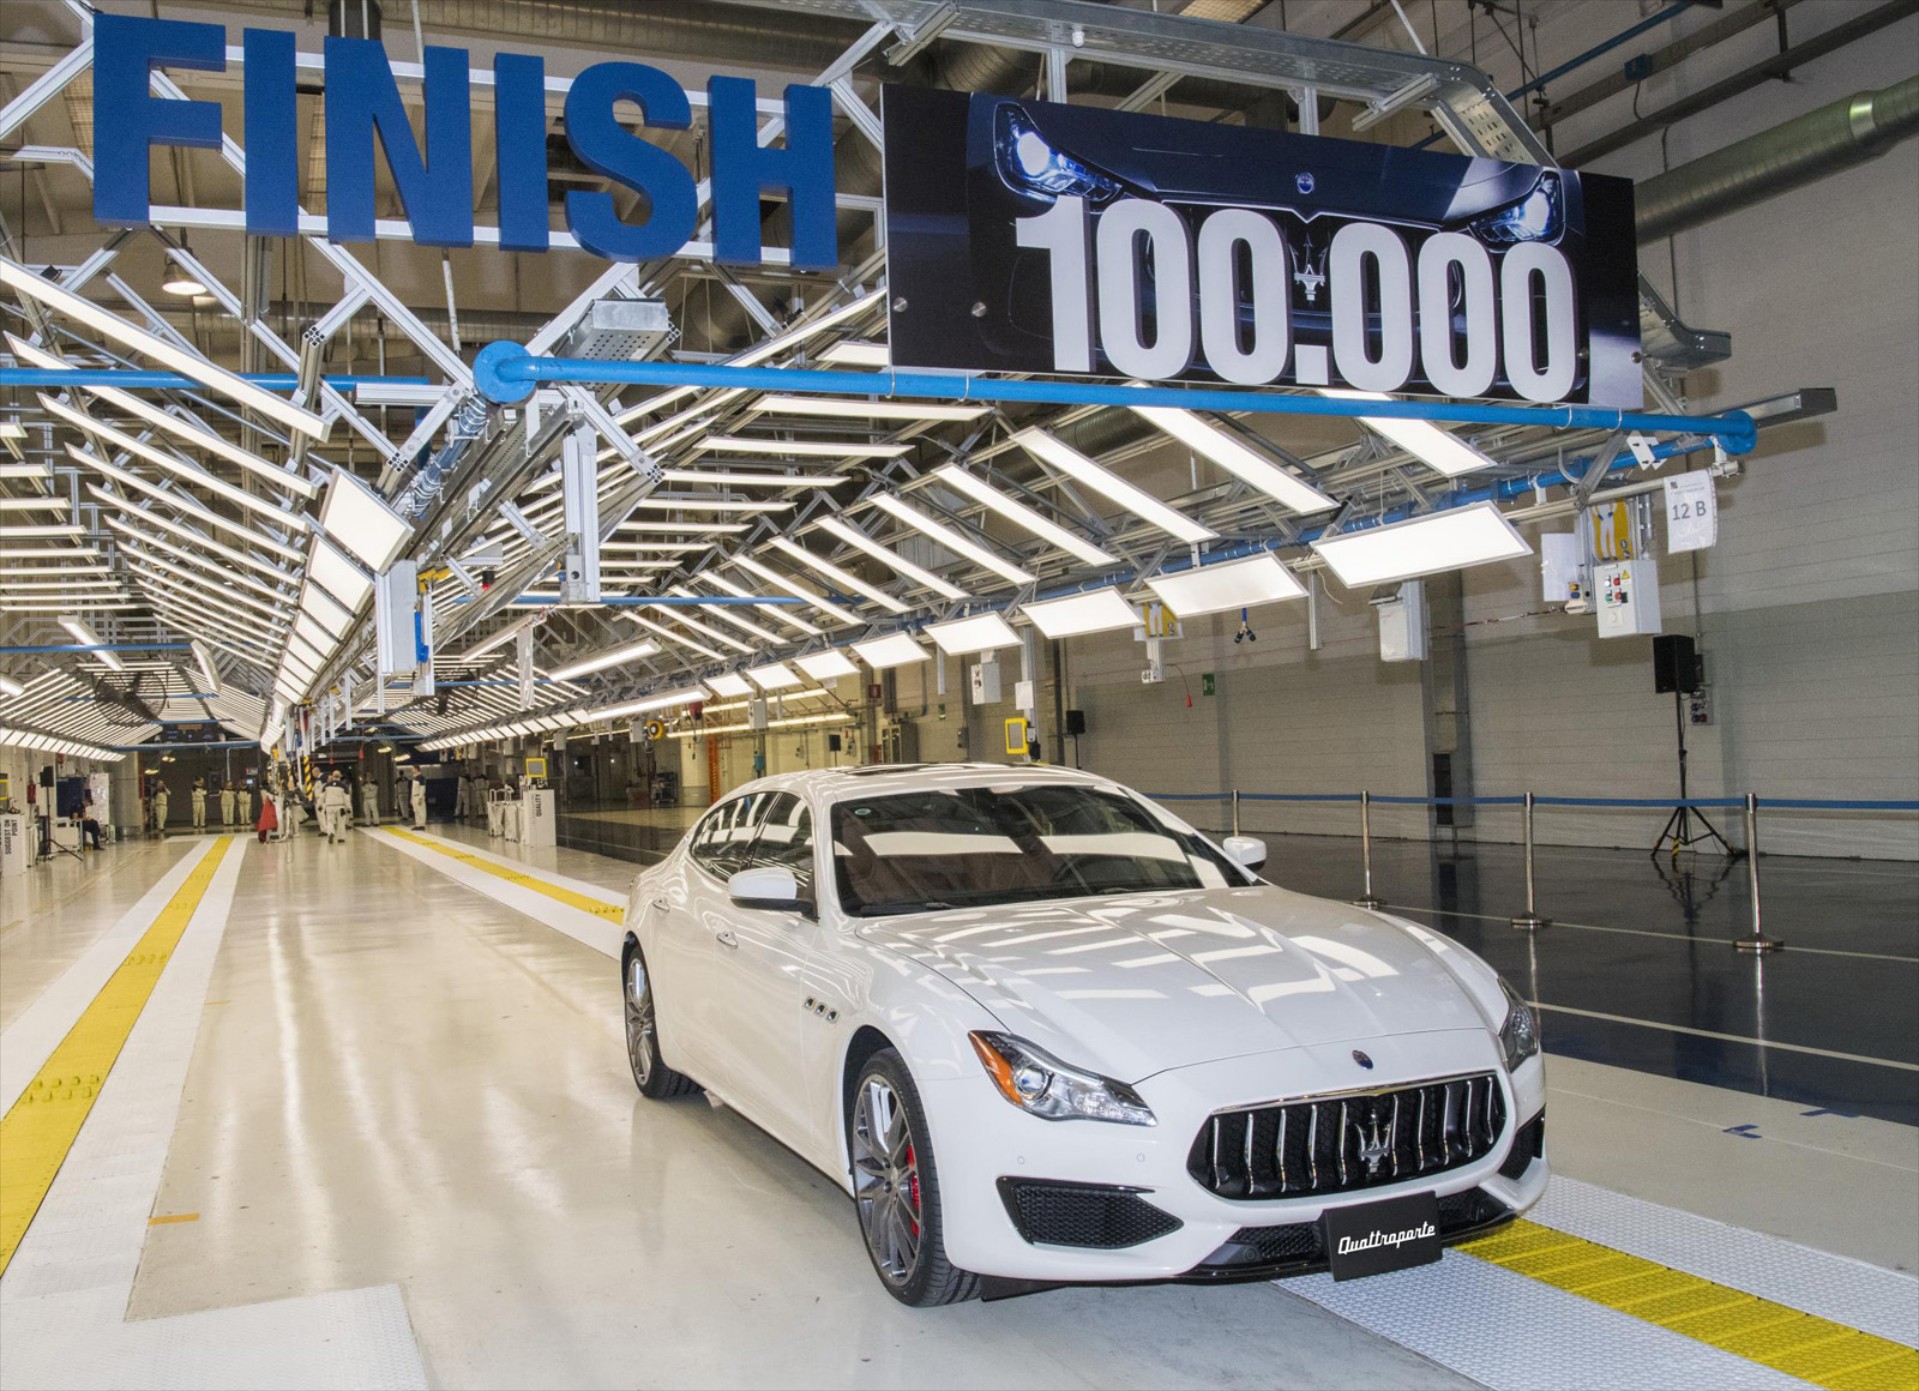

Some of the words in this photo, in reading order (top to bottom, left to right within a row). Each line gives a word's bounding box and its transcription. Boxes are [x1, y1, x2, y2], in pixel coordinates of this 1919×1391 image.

[93, 13, 838, 268] FINISH
[1015, 195, 1577, 403] 100.000
[1672, 503, 1691, 520] 12
[1695, 500, 1707, 517] B
[1338, 1221, 1436, 1255] Quattroporte
